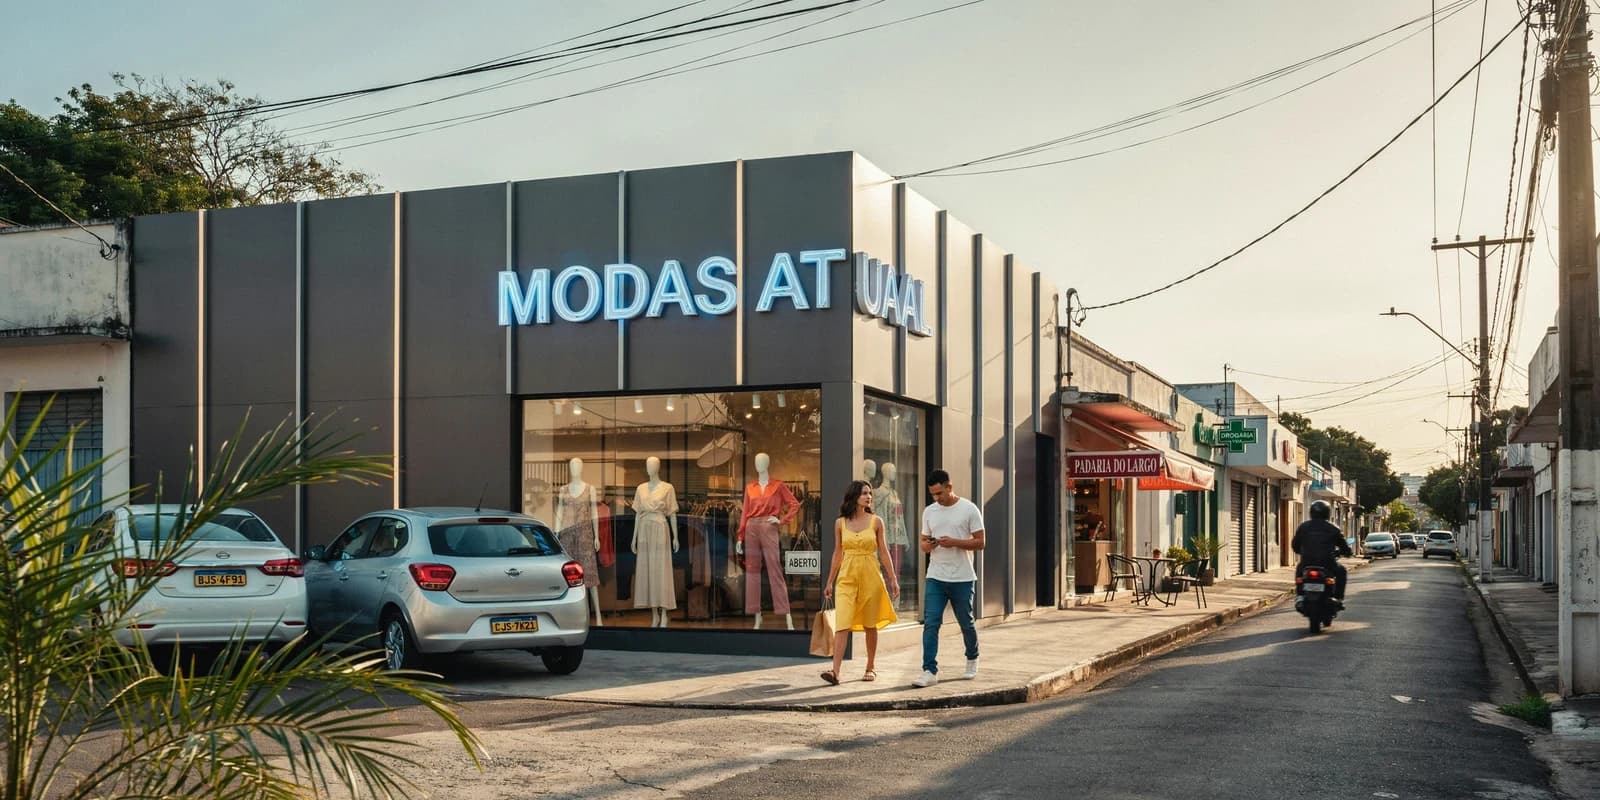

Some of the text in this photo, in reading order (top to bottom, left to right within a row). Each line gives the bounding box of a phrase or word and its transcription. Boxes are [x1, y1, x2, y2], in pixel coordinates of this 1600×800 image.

[498, 256, 738, 326] MODAS
[1074, 458, 1157, 474] PADARIA DO LARGO
[789, 558, 817, 568] ABERTO
